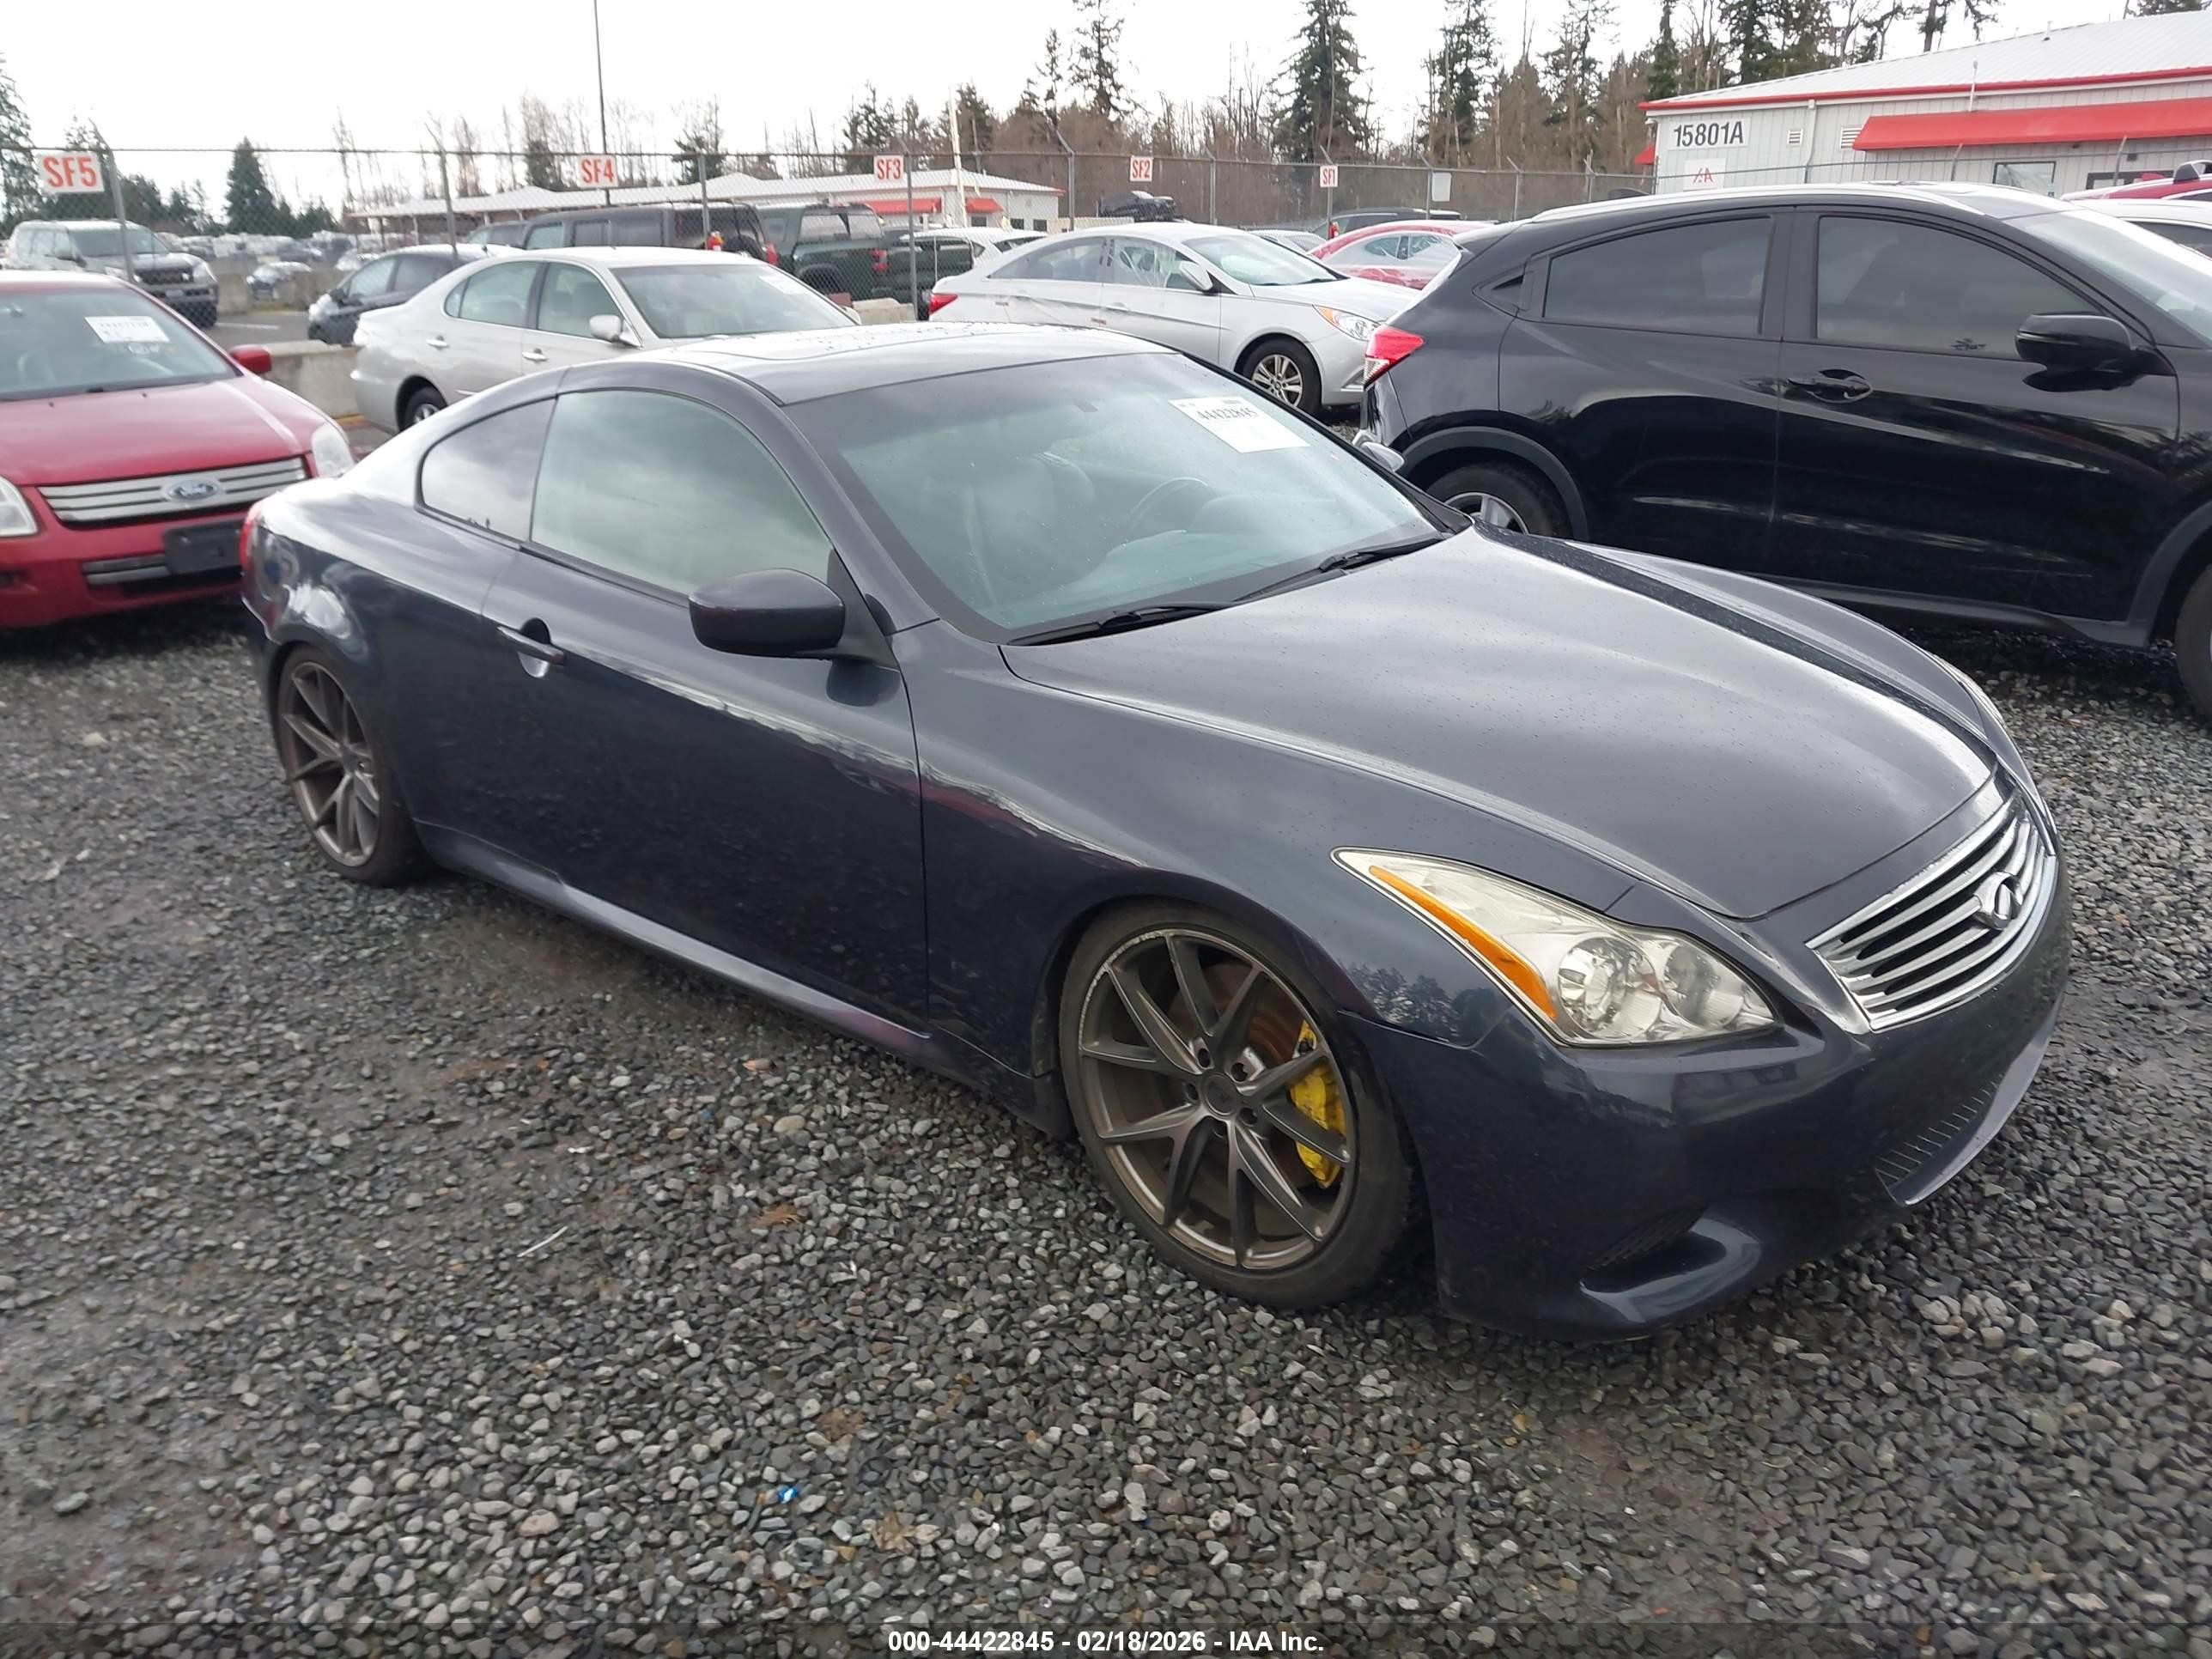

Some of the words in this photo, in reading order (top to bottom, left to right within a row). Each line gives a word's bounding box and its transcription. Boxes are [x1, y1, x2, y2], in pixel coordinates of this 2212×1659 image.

[1674, 121, 1744, 147] 15801A
[43, 156, 97, 187] SF5
[581, 158, 614, 183] SF4
[877, 159, 901, 179] SF3
[1133, 160, 1151, 179] SF2
[1322, 167, 1335, 185] SF1
